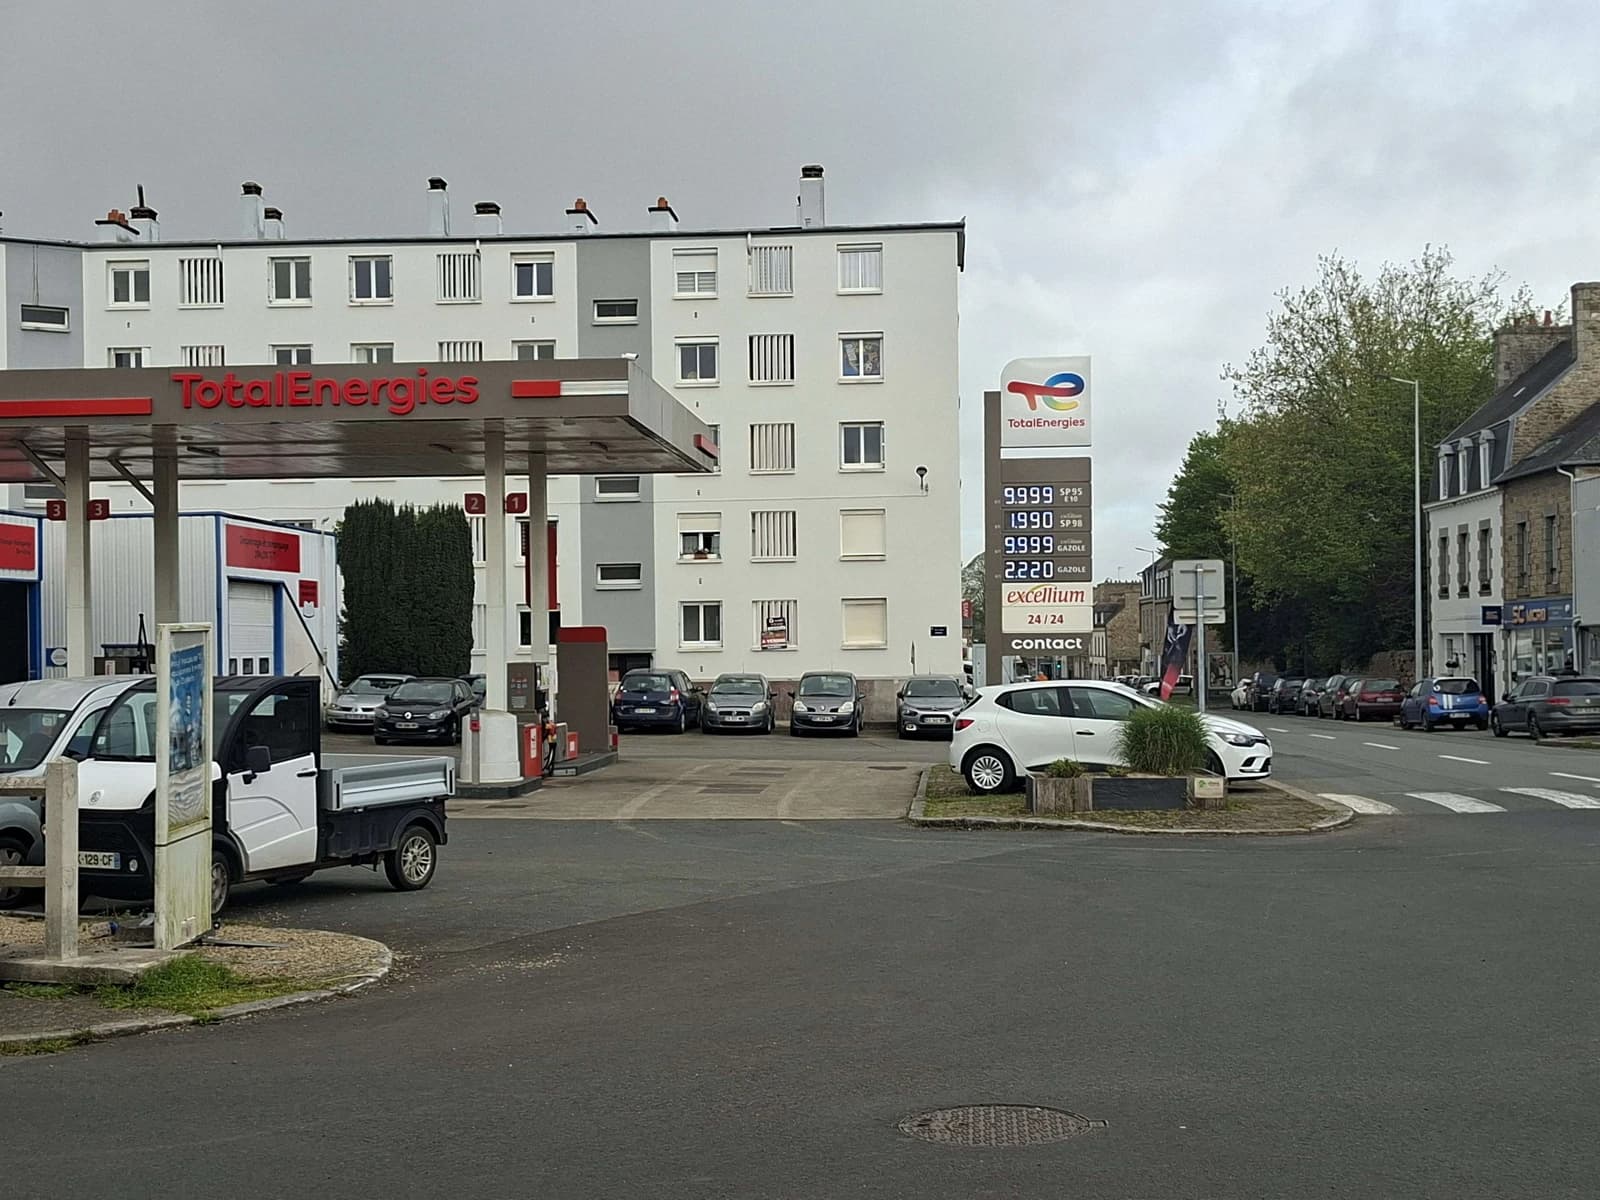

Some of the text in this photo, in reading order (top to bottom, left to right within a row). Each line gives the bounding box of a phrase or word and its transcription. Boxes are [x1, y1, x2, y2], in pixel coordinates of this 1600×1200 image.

[171, 367, 480, 415] TotalEnergies
[1007, 417, 1086, 429] TotalEnergies
[52, 503, 61, 517] 3
[94, 502, 103, 516] 3
[470, 497, 480, 510] 2
[511, 496, 520, 510] 1
[1057, 544, 1086, 552] GAZOLE
[1007, 586, 1085, 604] excellium
[1011, 637, 1083, 650] contact
